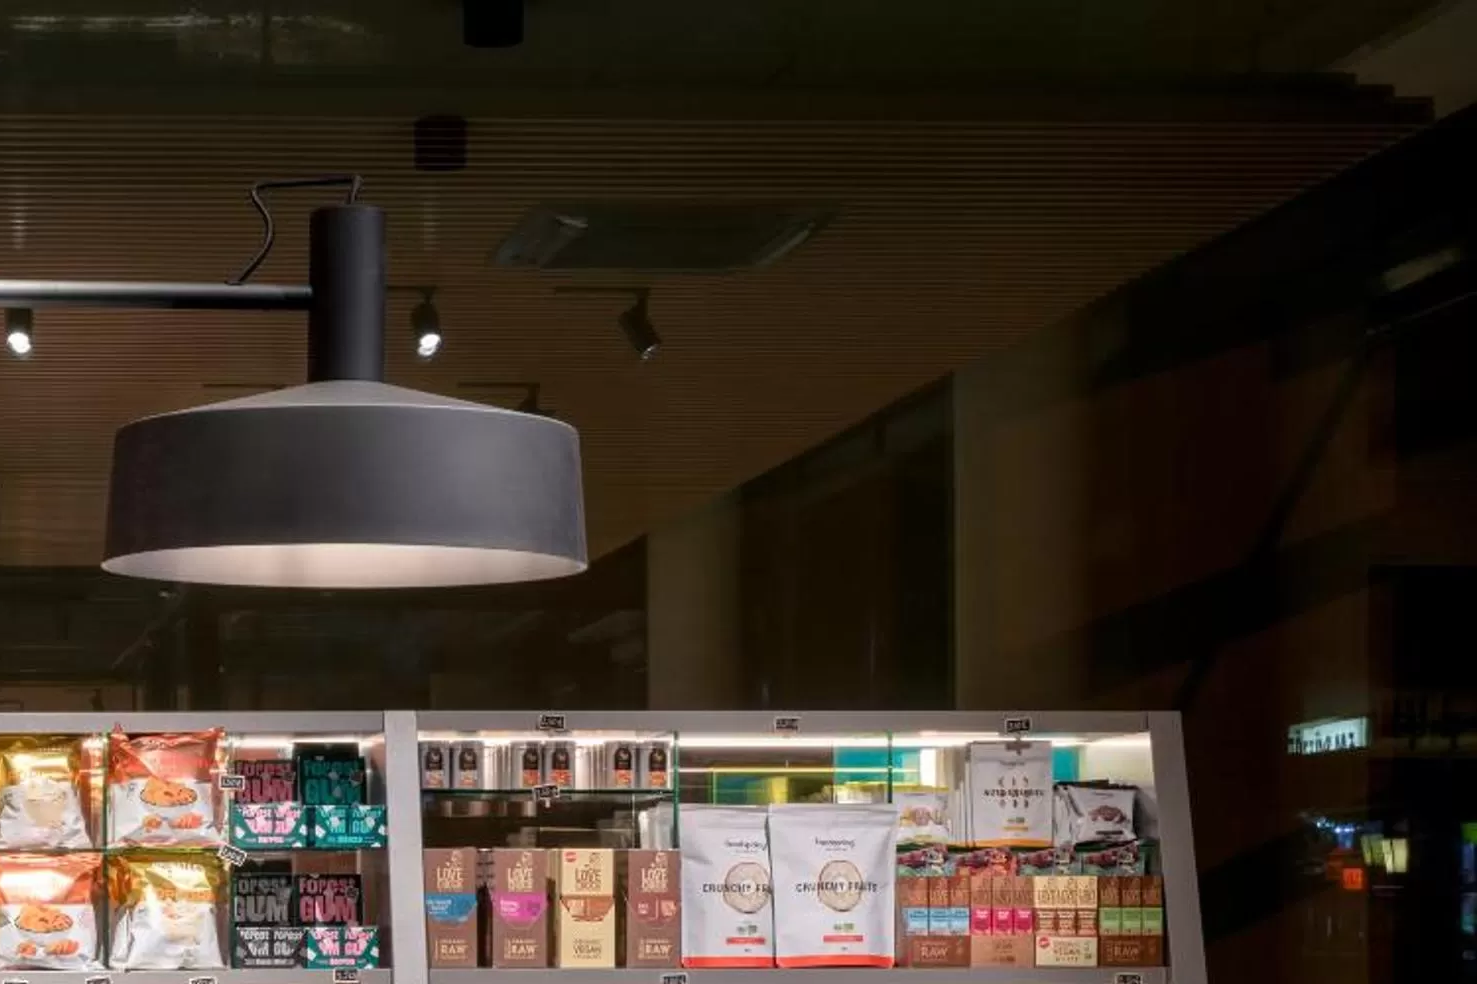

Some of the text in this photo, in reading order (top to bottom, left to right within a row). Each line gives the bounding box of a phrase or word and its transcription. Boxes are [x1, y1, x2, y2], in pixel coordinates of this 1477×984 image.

[236, 778, 293, 803] GUM
[305, 779, 361, 805] GUM
[574, 867, 602, 881] LOVE
[238, 878, 287, 895] orest
[702, 883, 753, 893] CRUNCHY
[794, 881, 879, 893] CRUNCHY FRUITS
[234, 895, 289, 923] GUM
[299, 895, 357, 923] GUM
[440, 944, 469, 954] RAW
[510, 944, 539, 954] RAW
[644, 943, 673, 954] RAW
[920, 946, 949, 958] RAW
